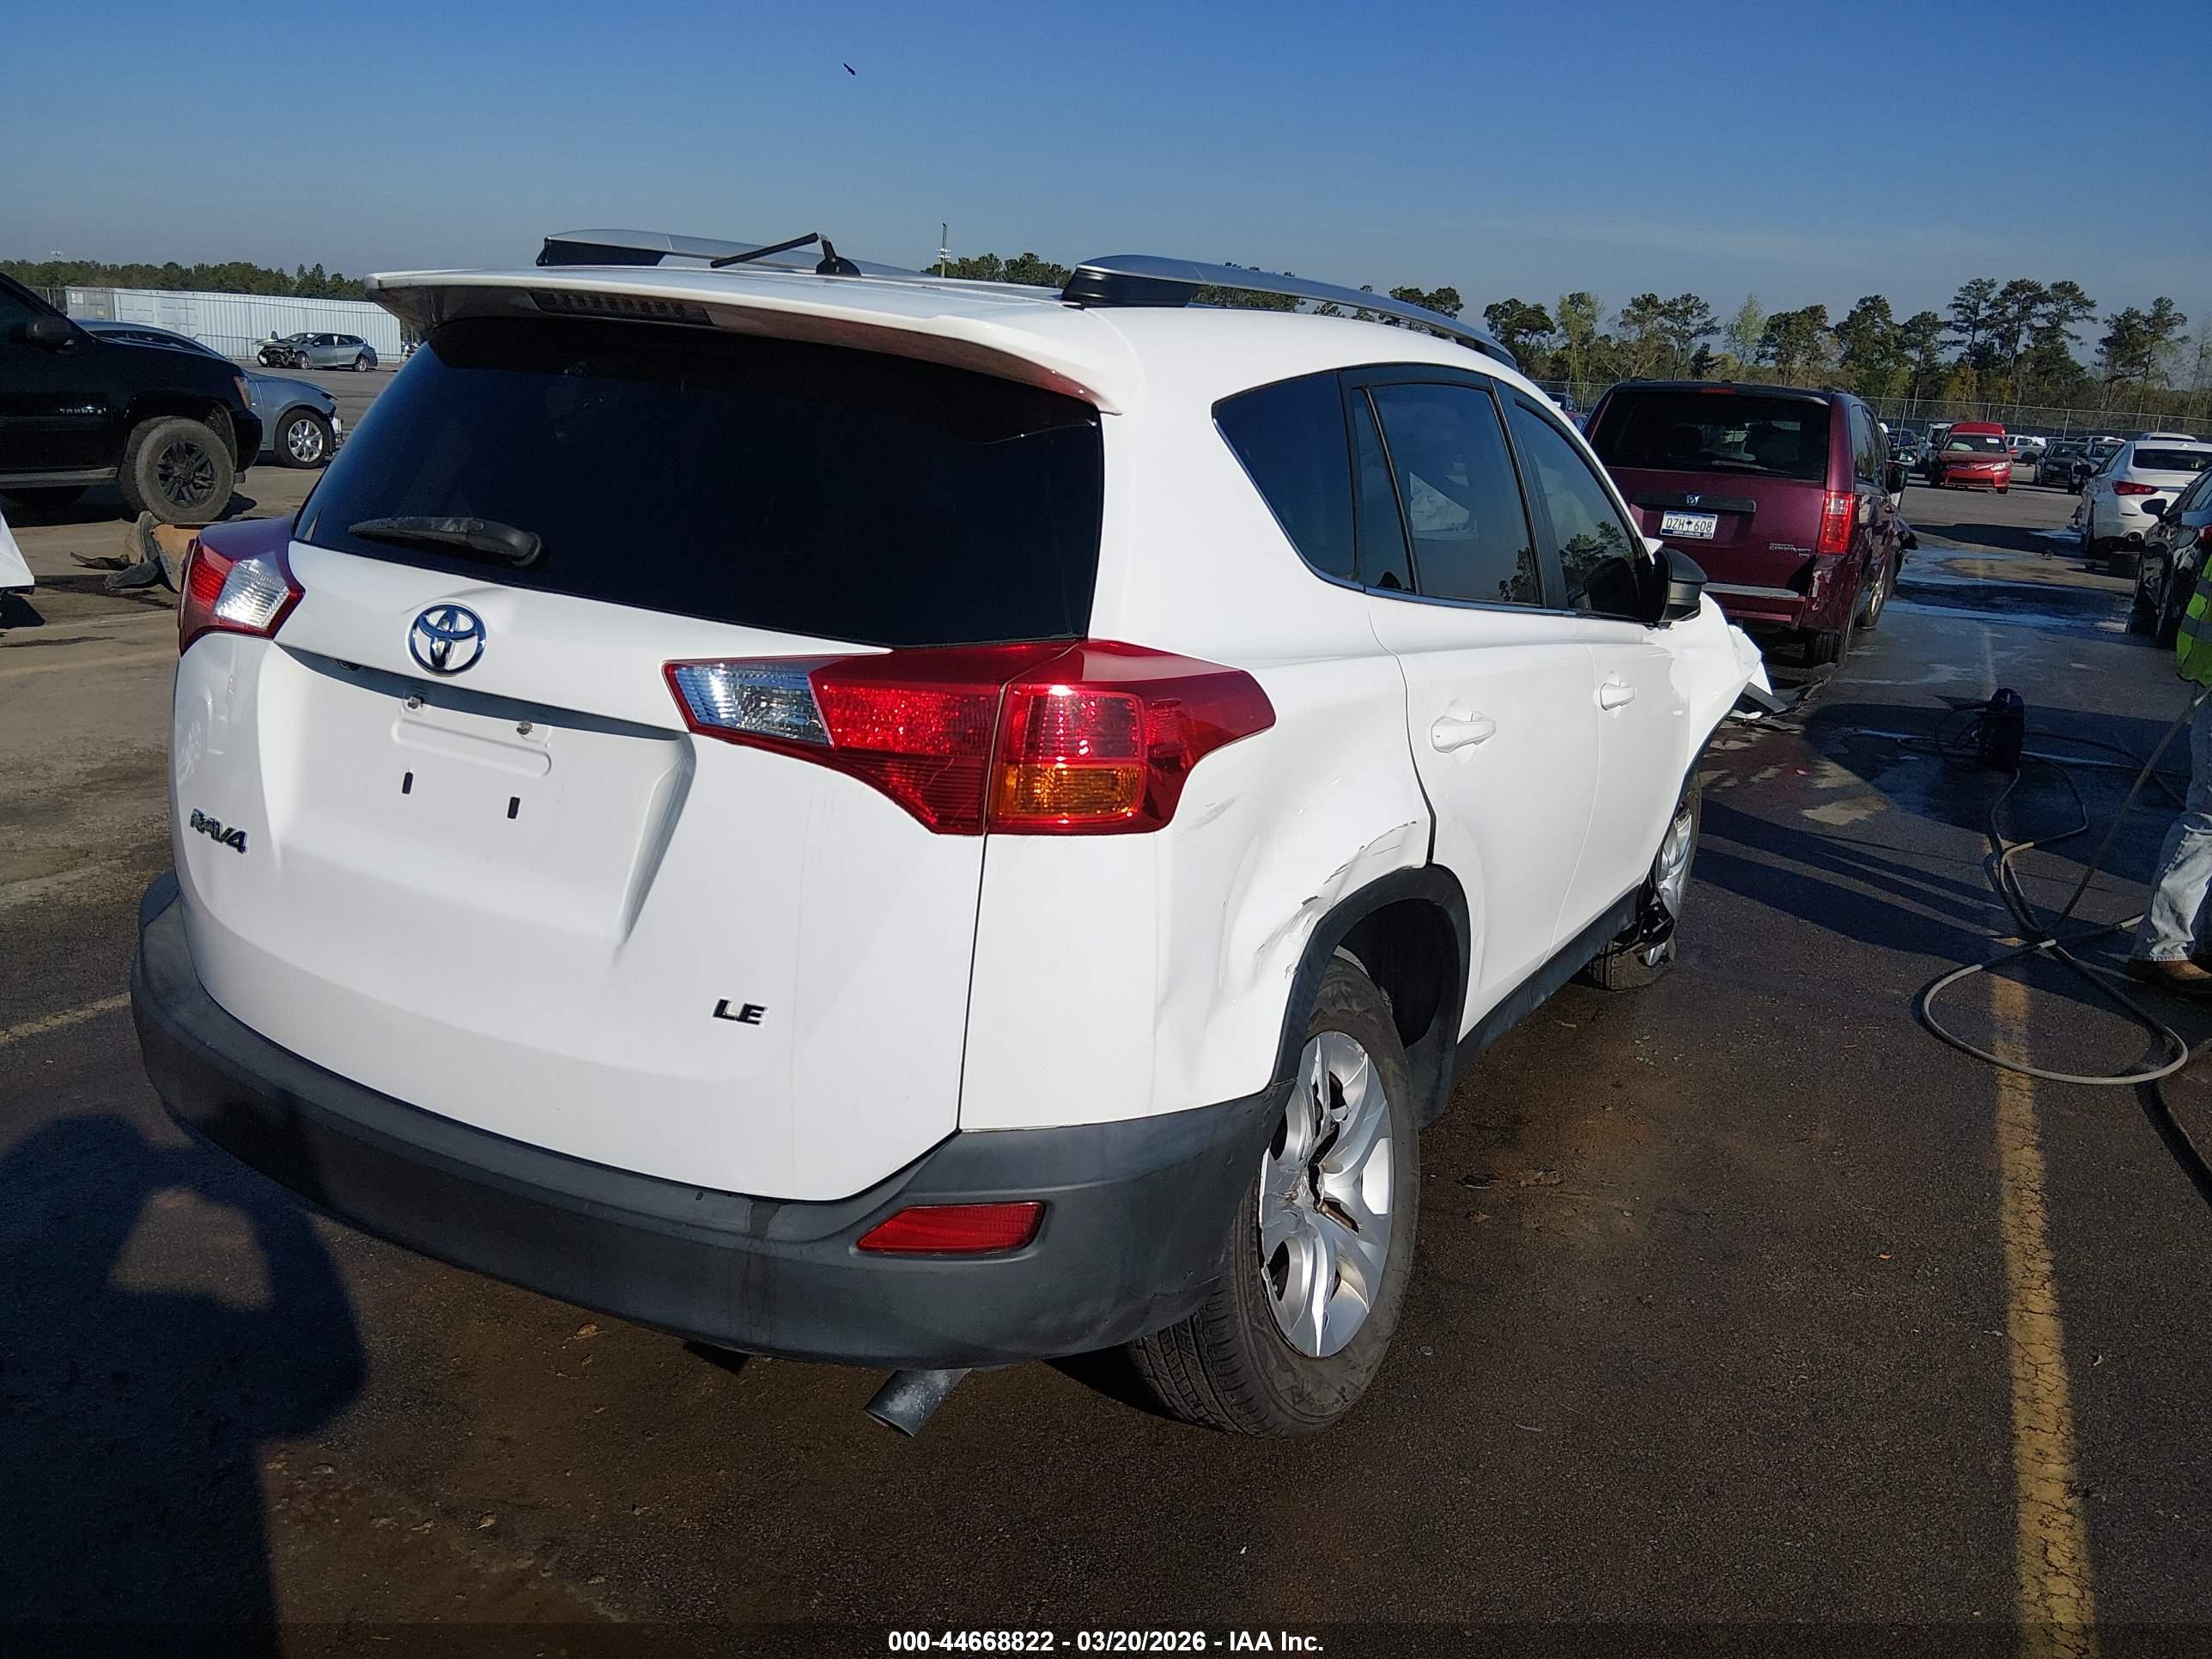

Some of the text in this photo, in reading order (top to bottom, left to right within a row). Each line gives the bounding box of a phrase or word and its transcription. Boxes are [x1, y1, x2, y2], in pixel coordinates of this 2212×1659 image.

[1693, 520, 1713, 532] 608
[190, 808, 247, 854] RAV4
[713, 999, 768, 1025] LE
